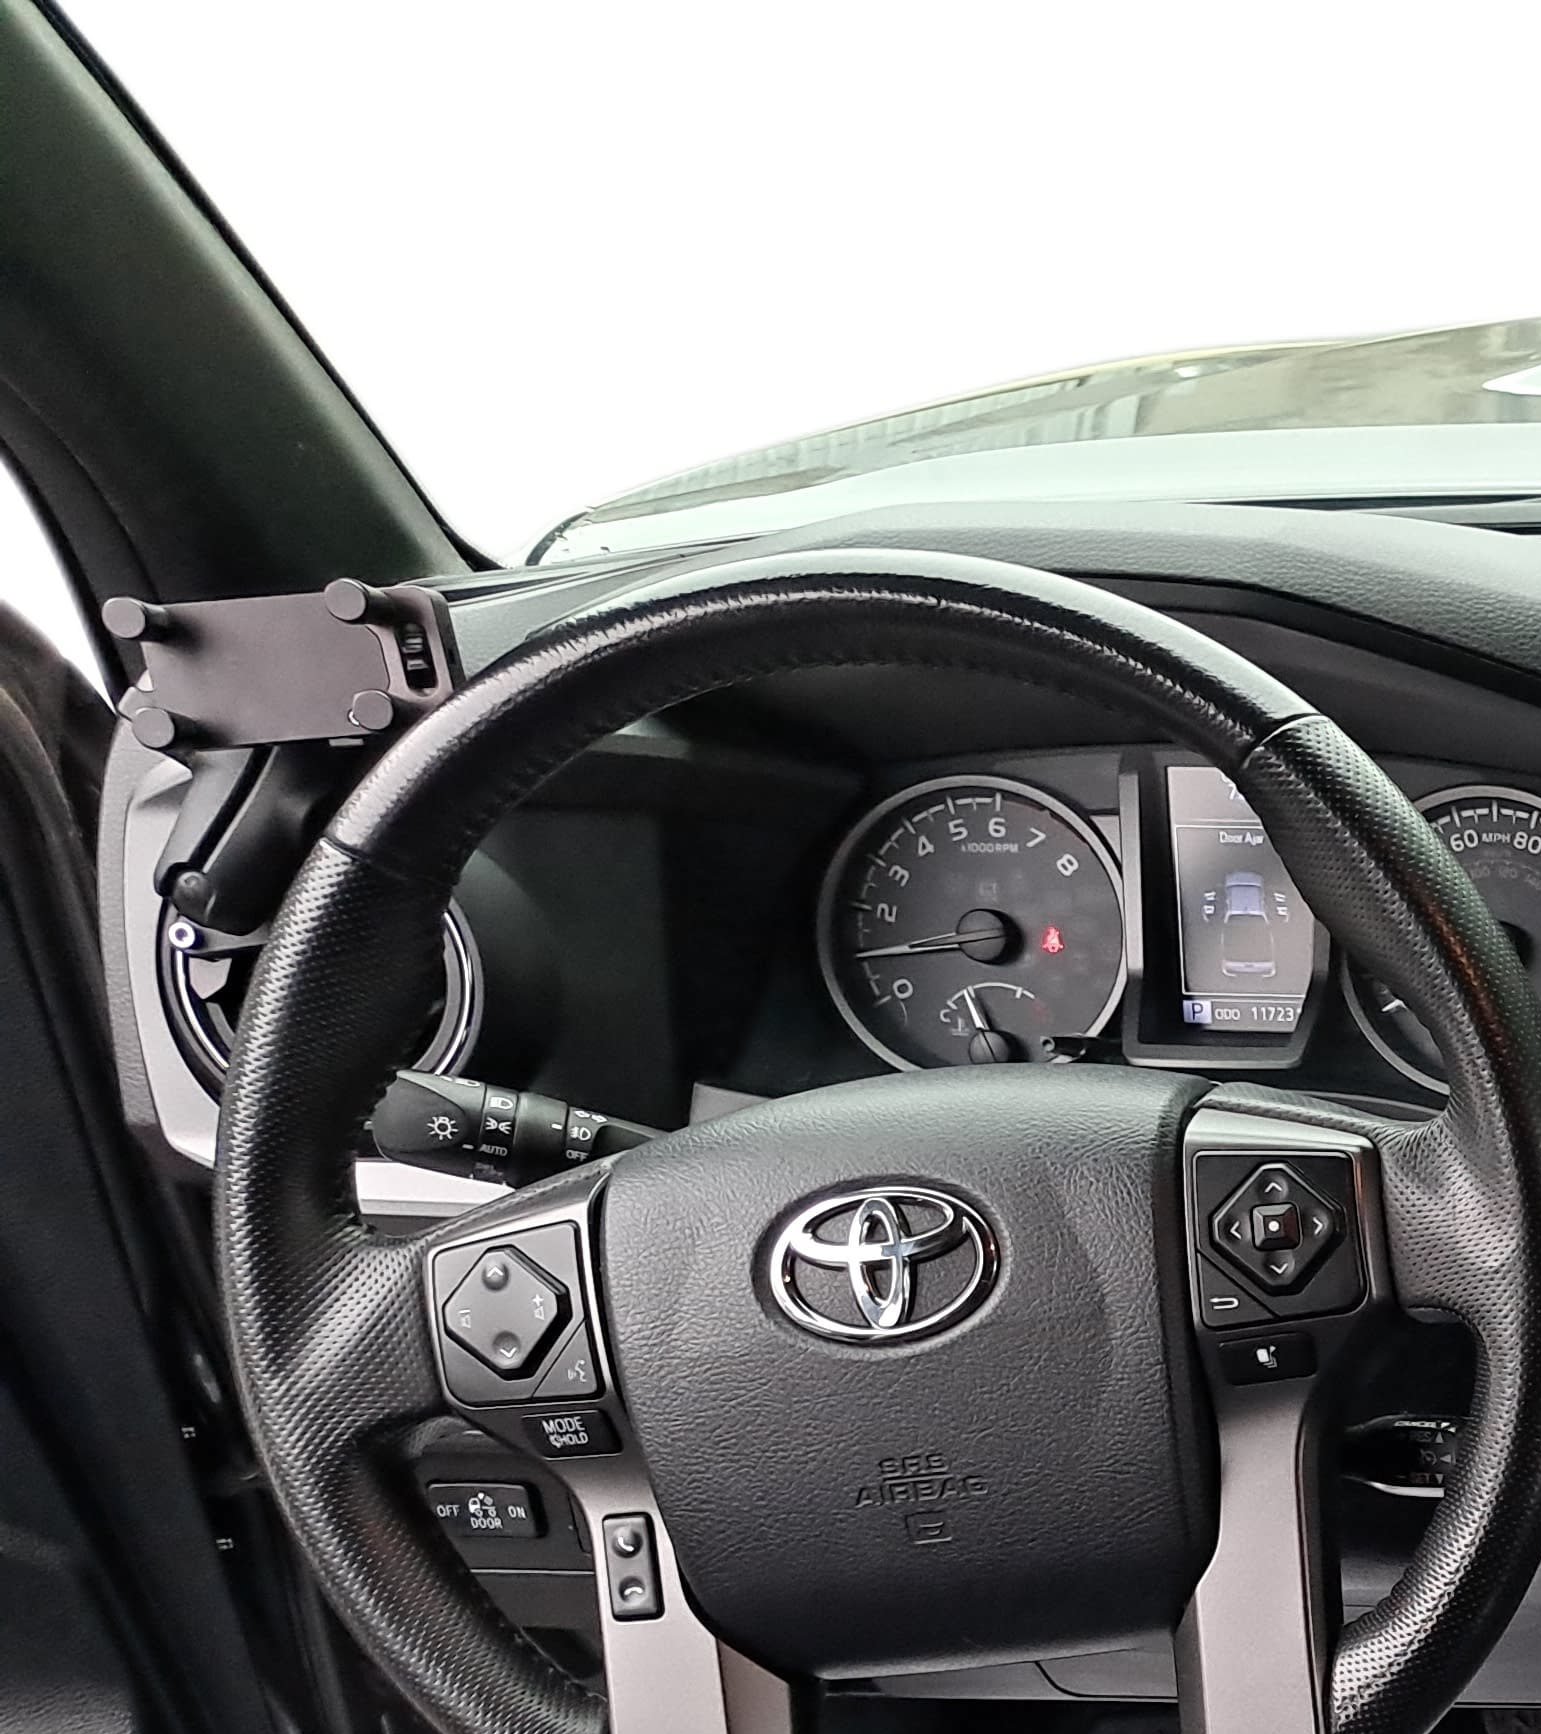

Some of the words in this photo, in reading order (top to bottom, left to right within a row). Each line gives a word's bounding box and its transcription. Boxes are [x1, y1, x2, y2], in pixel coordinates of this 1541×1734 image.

[948, 819, 968, 841] 5
[988, 817, 1006, 838] 6
[917, 835, 935, 857] 4
[1025, 827, 1046, 848] 7
[1450, 829, 1479, 852] 60
[1481, 832, 1511, 845] MPH
[1056, 853, 1079, 877] 8
[888, 865, 910, 887] 3
[877, 903, 897, 923] 2
[892, 978, 914, 999] 0
[1190, 1003, 1204, 1021] P
[1215, 1007, 1241, 1021] ODO
[1251, 1006, 1301, 1022] 11723
[480, 1144, 508, 1157] AUTO
[566, 1150, 589, 1162] OFF
[542, 1416, 586, 1434] MODE
[559, 1432, 589, 1445] HOLD
[436, 1505, 460, 1517] OFF
[508, 1506, 527, 1519] ON
[471, 1517, 503, 1529] DOOR
